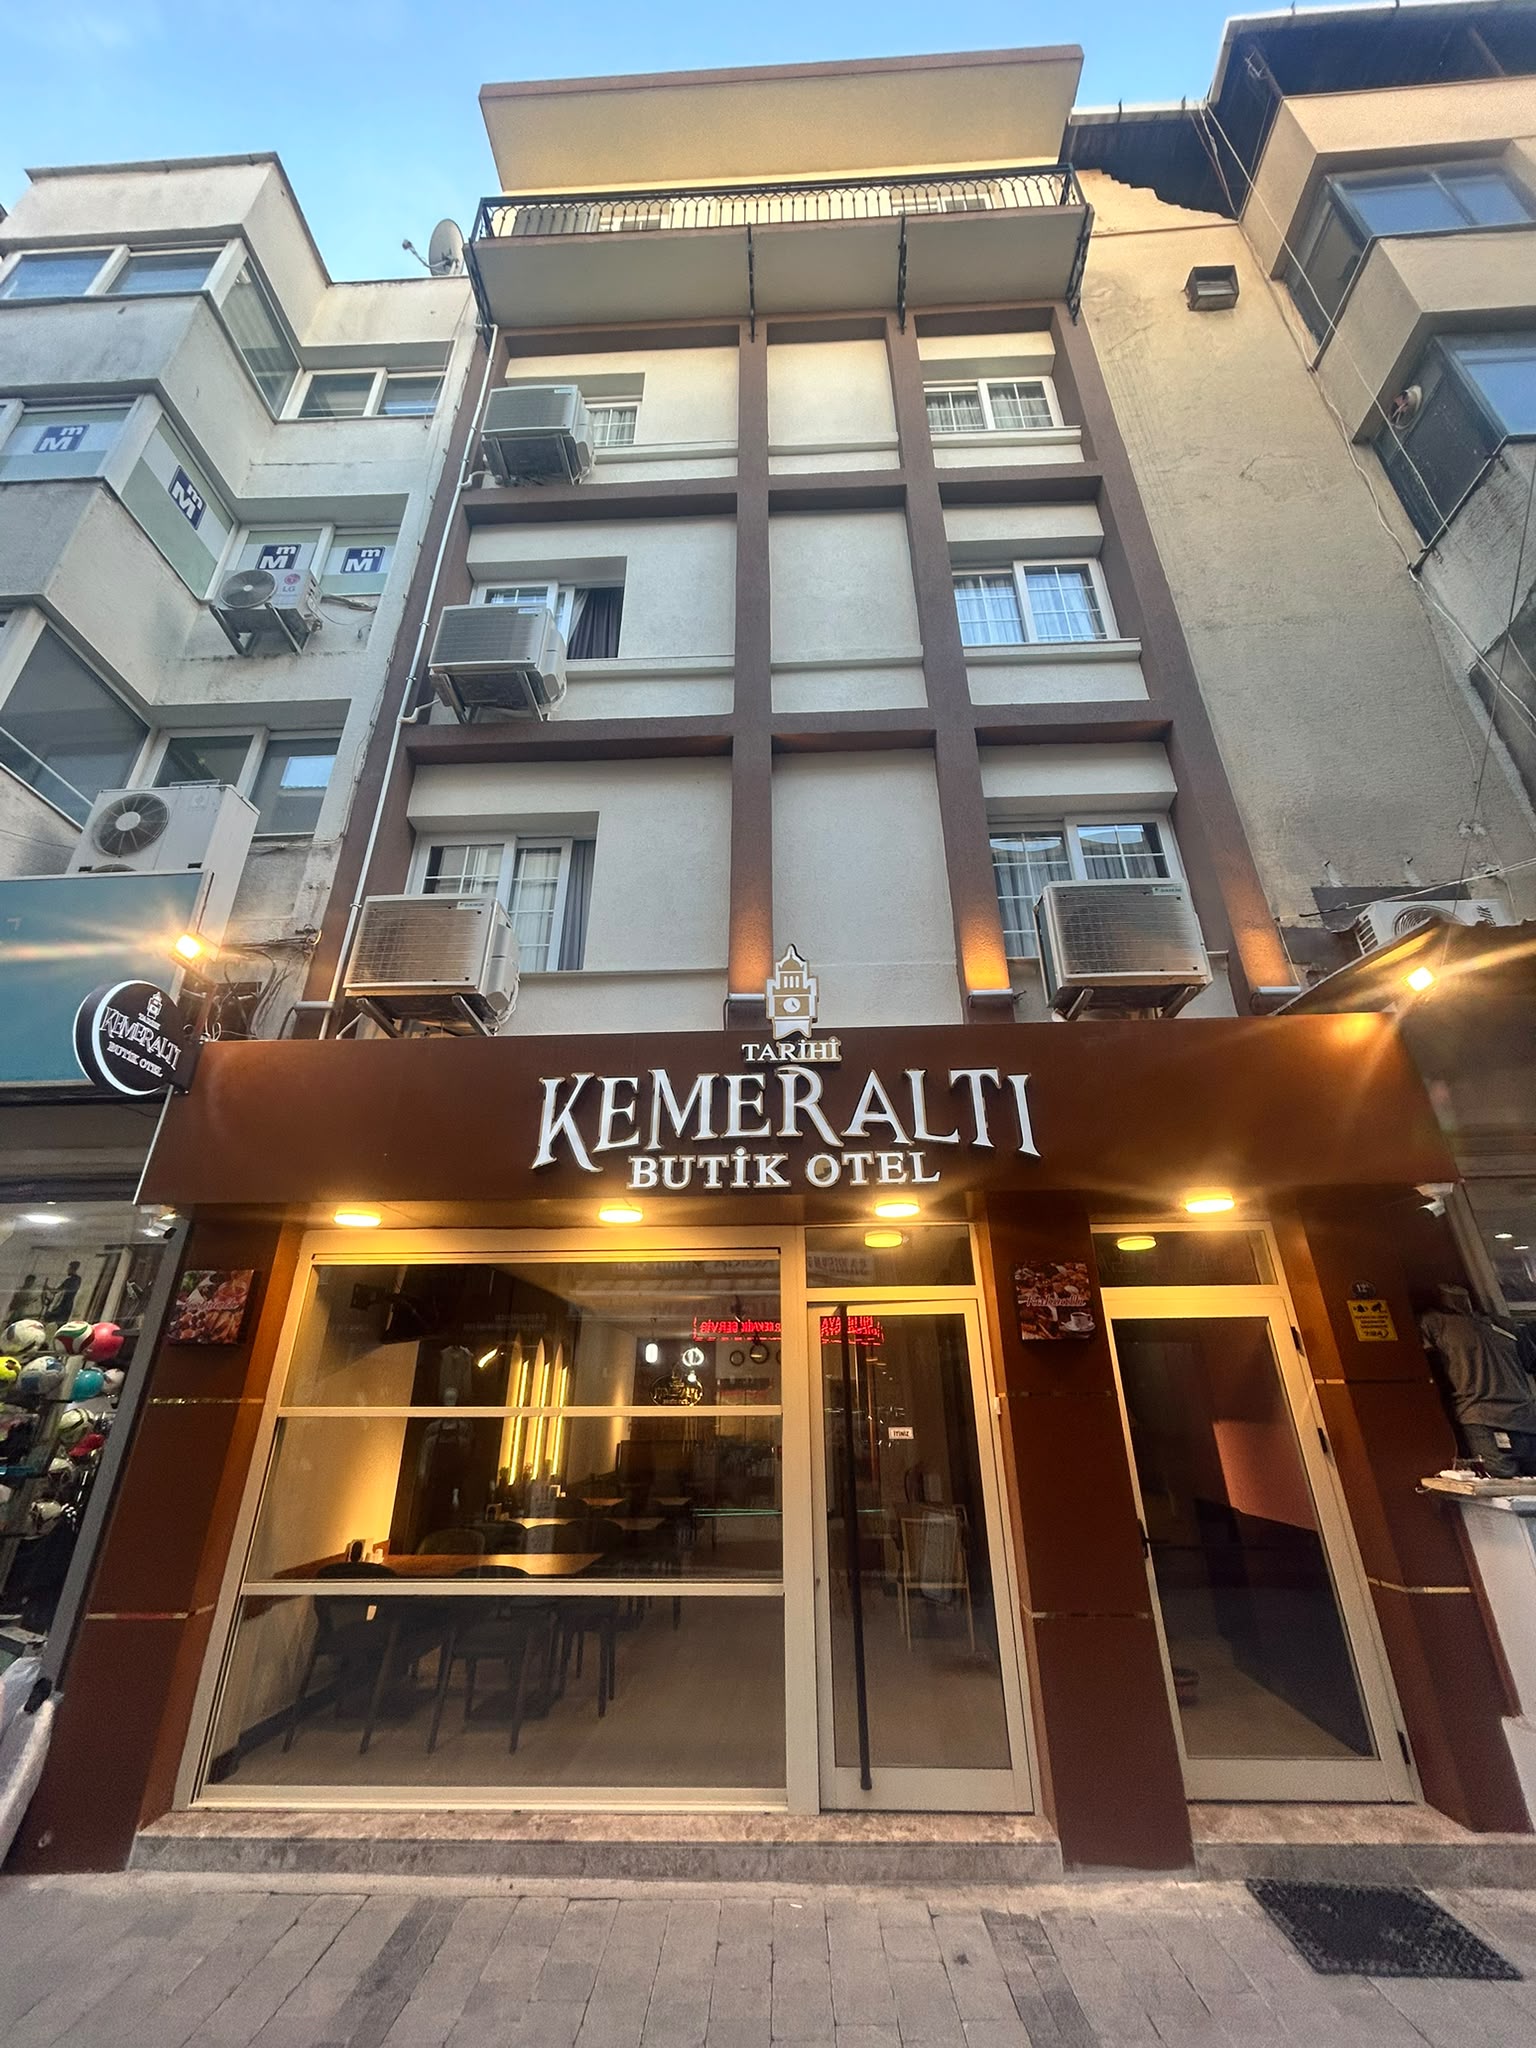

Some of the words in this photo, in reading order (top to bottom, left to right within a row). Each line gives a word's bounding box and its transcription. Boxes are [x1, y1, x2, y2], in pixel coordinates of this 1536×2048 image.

[99, 1006, 182, 1071] KEMERALTI
[741, 1036, 842, 1063] TARİHİ
[139, 1058, 163, 1078] OTEL
[530, 1065, 1042, 1173] KEMERALTI
[626, 1146, 791, 1189] BUTİK
[805, 1151, 941, 1188] OTEL
